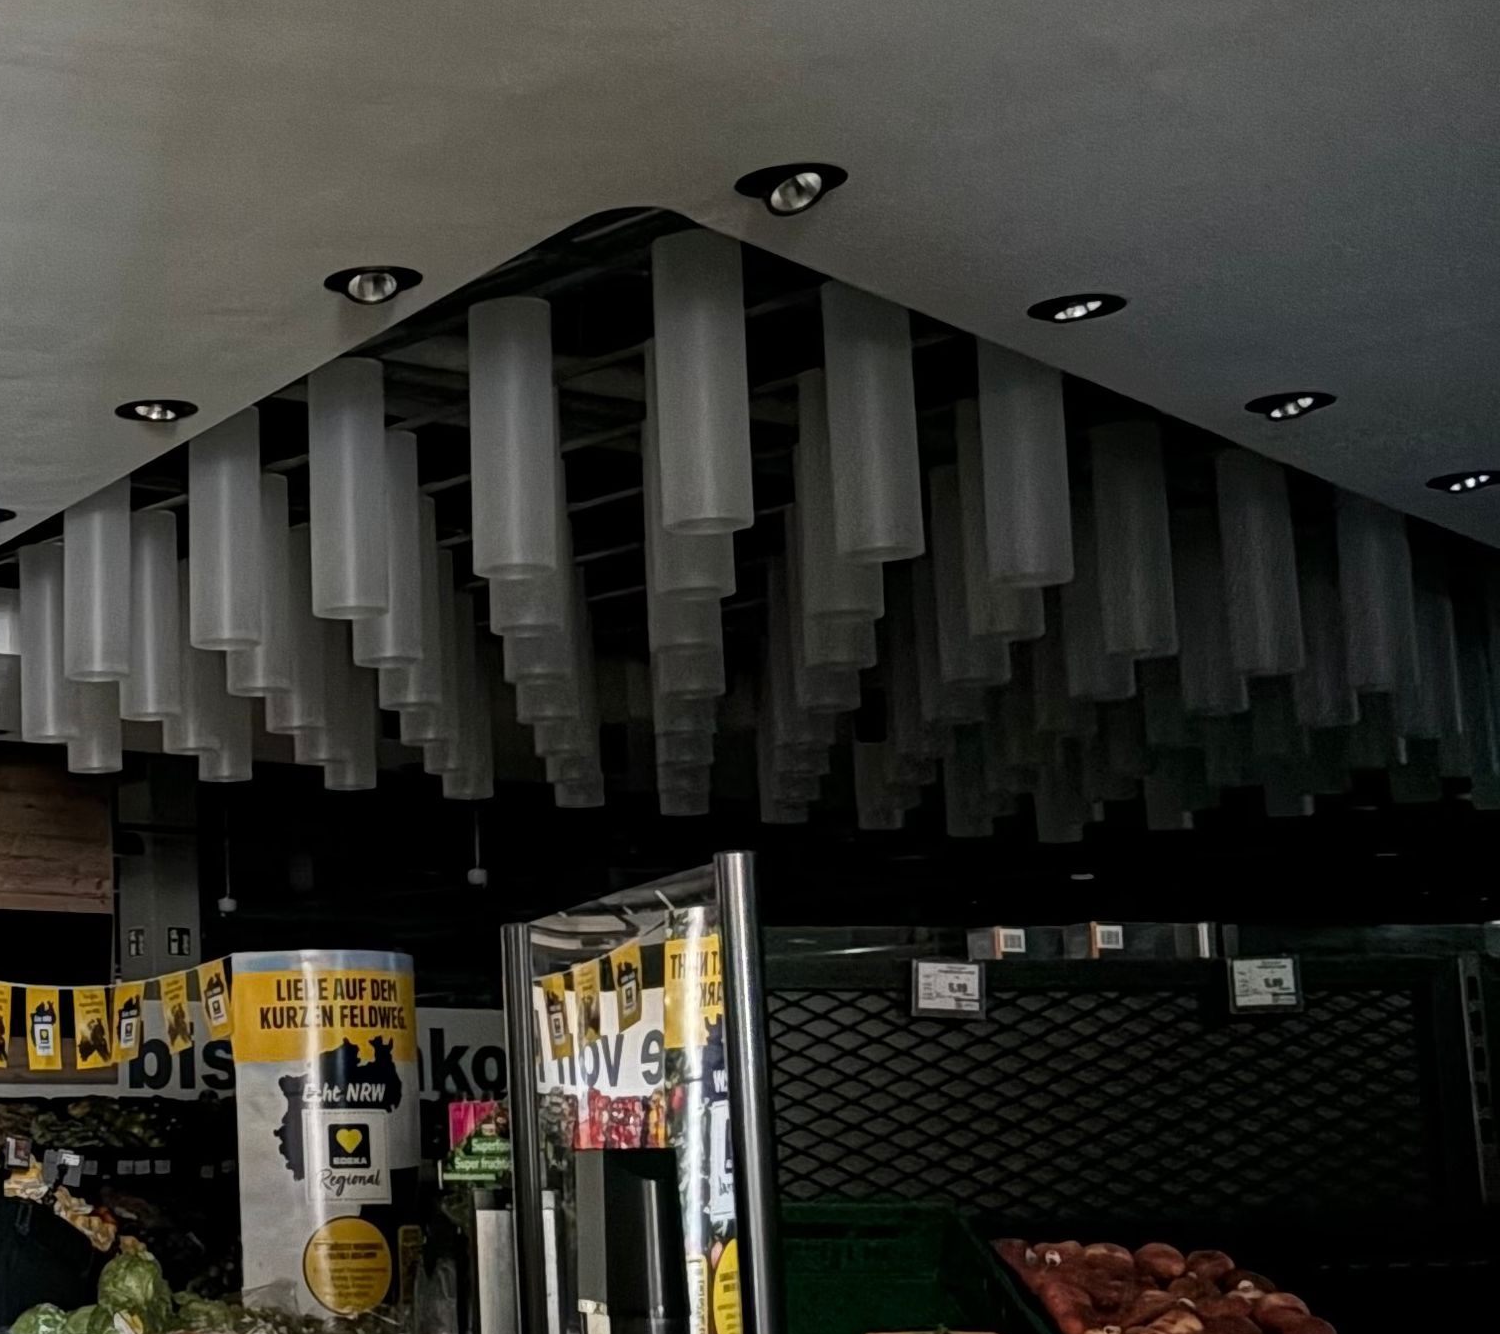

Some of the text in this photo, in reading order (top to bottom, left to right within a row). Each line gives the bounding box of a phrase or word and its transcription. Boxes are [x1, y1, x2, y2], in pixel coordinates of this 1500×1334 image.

[276, 977, 397, 1003] LIEE AUF DEM
[345, 1082, 386, 1103] NRW
[320, 1168, 381, 1197] Regional
